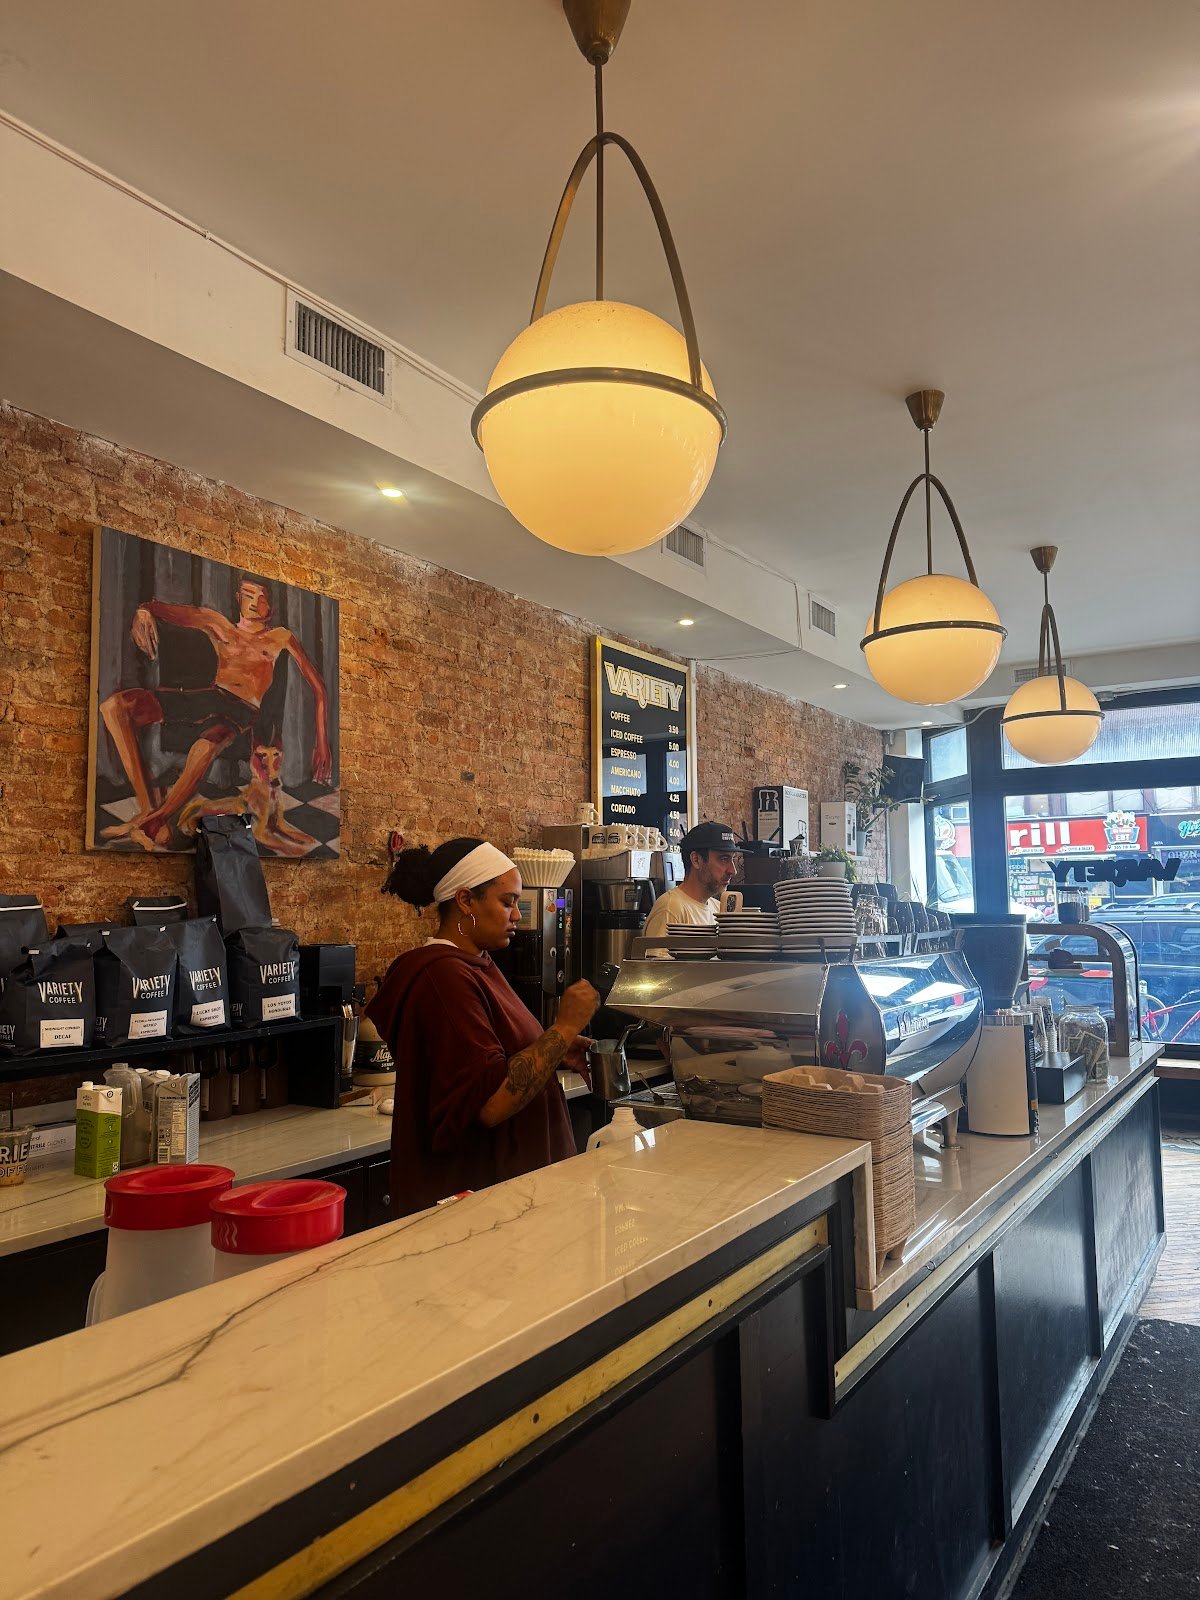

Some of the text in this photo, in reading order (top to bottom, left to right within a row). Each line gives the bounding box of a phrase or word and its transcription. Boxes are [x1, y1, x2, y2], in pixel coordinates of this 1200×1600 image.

[604, 661, 683, 711] VARIETY
[610, 710, 631, 723] COFFEE
[668, 724, 679, 735] 3.50
[610, 728, 643, 744] ICED COFFEE
[668, 741, 680, 752] 5.00
[610, 747, 637, 760] ESPRESSO
[668, 759, 680, 769] 4.00
[610, 766, 642, 779] AMERICANO
[668, 776, 680, 785] 4.00
[610, 784, 641, 797] MACCHIATO
[669, 793, 680, 803] 4.25
[610, 803, 636, 815] CORTADO
[669, 810, 680, 820] 4.50
[669, 828, 680, 838] 5.00
[1009, 821, 1070, 847] rill
[189, 966, 222, 991] VARIETY
[260, 961, 296, 985] VARIETY
[196, 981, 218, 991] COFFEE
[268, 975, 291, 985] COFFEE
[37, 981, 83, 1003] VARIETY
[132, 974, 171, 999] VARIETY
[48, 996, 76, 1004] COFFEE
[140, 990, 165, 1000] COFFEE
